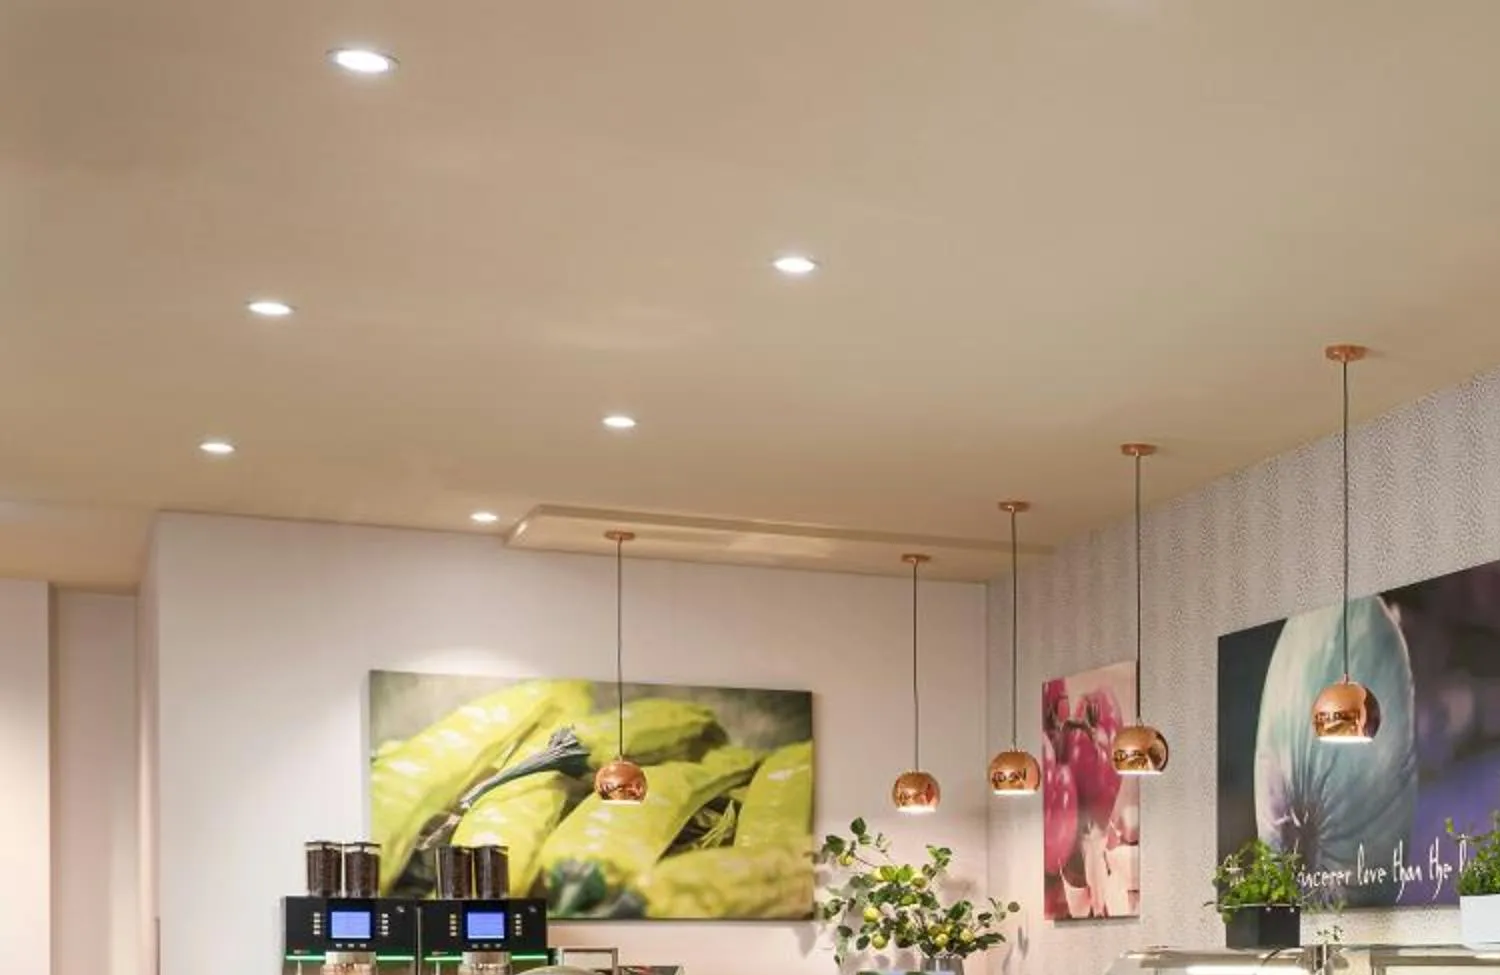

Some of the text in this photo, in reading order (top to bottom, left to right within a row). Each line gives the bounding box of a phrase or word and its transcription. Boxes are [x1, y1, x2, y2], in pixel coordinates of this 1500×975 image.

[1357, 842, 1387, 886] love
[1393, 838, 1423, 903] than
[1429, 836, 1453, 901] the
